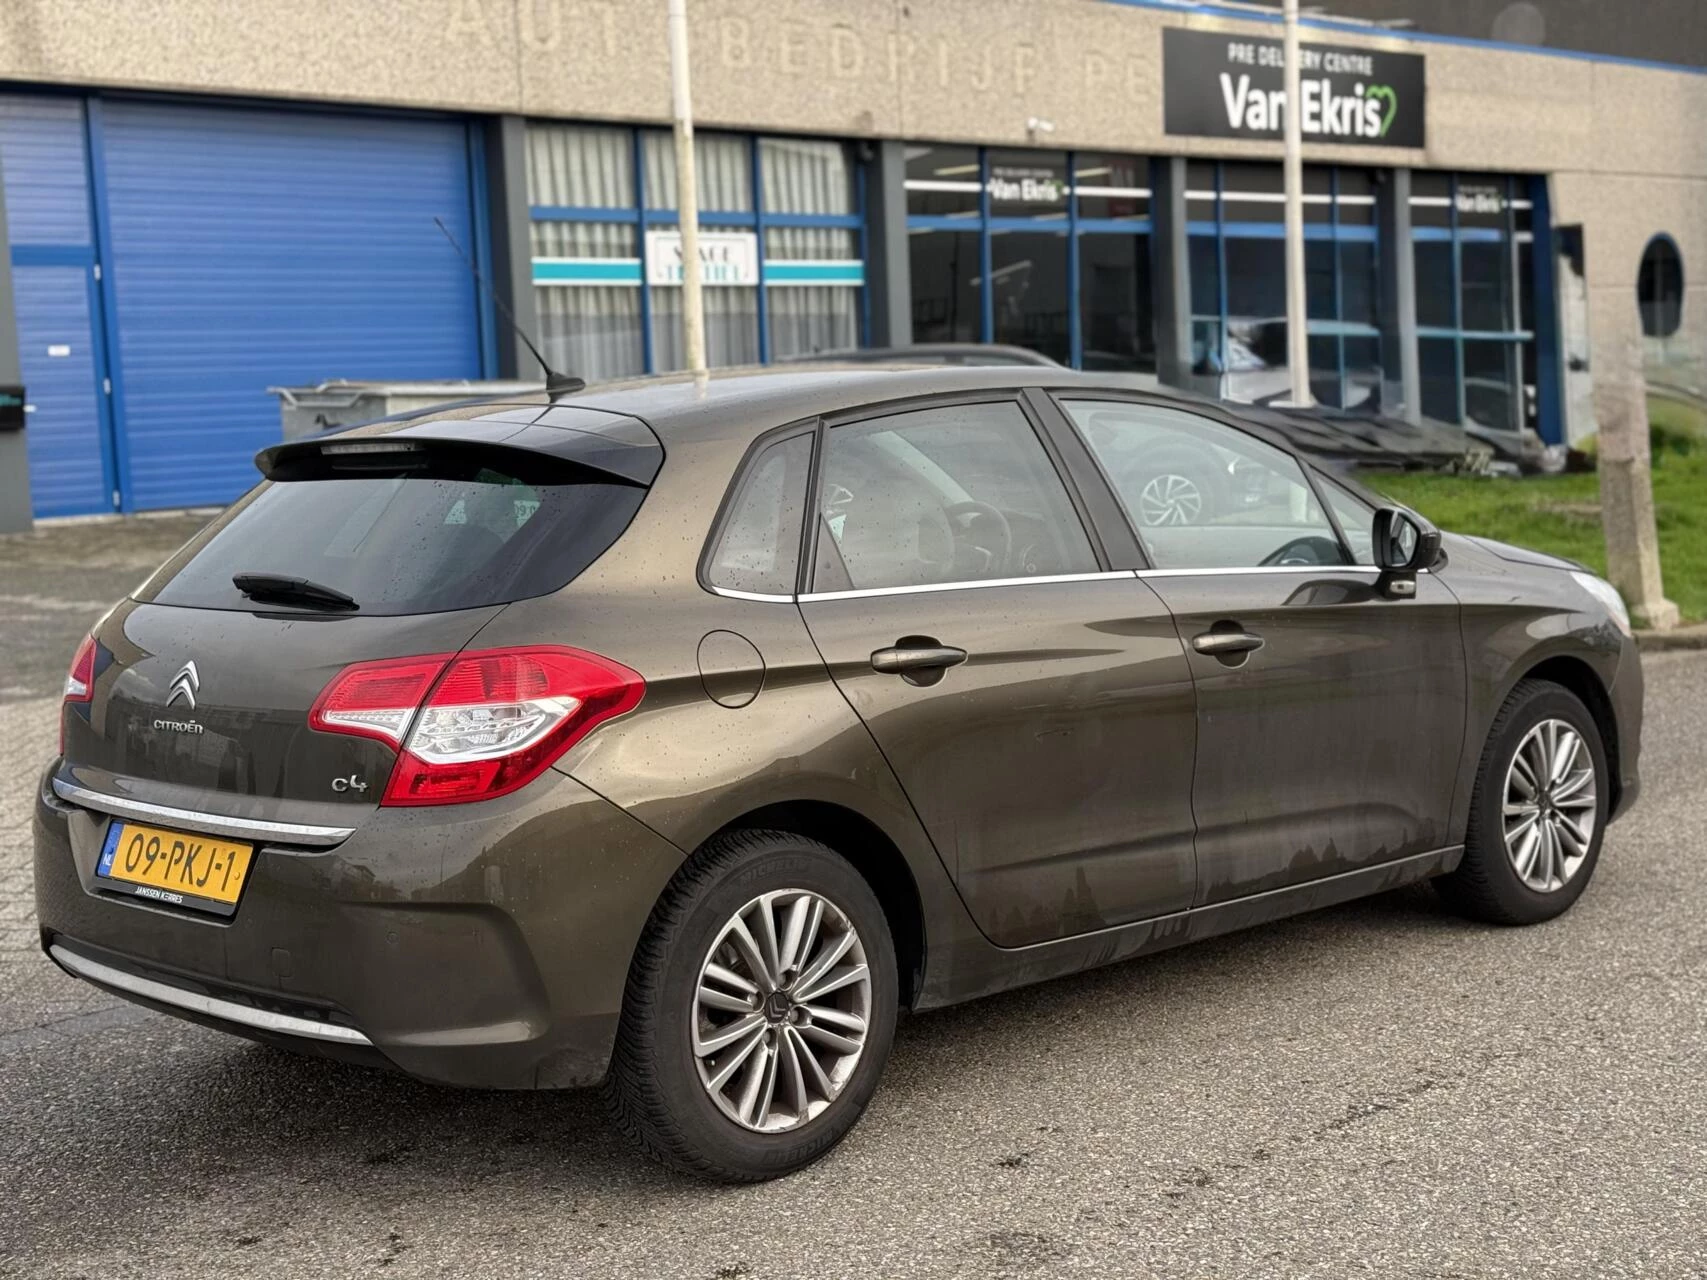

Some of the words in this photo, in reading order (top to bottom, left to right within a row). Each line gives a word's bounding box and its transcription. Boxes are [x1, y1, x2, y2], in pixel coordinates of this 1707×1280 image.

[1227, 42, 1255, 64] PRE
[1257, 45, 1322, 70] DELERY
[1324, 52, 1373, 77] CENTRE
[1219, 72, 1288, 131] Van
[1300, 78, 1382, 138] Ekris
[153, 719, 204, 734] CITROËN
[331, 774, 369, 793] C4
[102, 853, 113, 866] NL
[125, 833, 237, 892] 09-PKJ-1
[135, 885, 161, 899] JANSSEN
